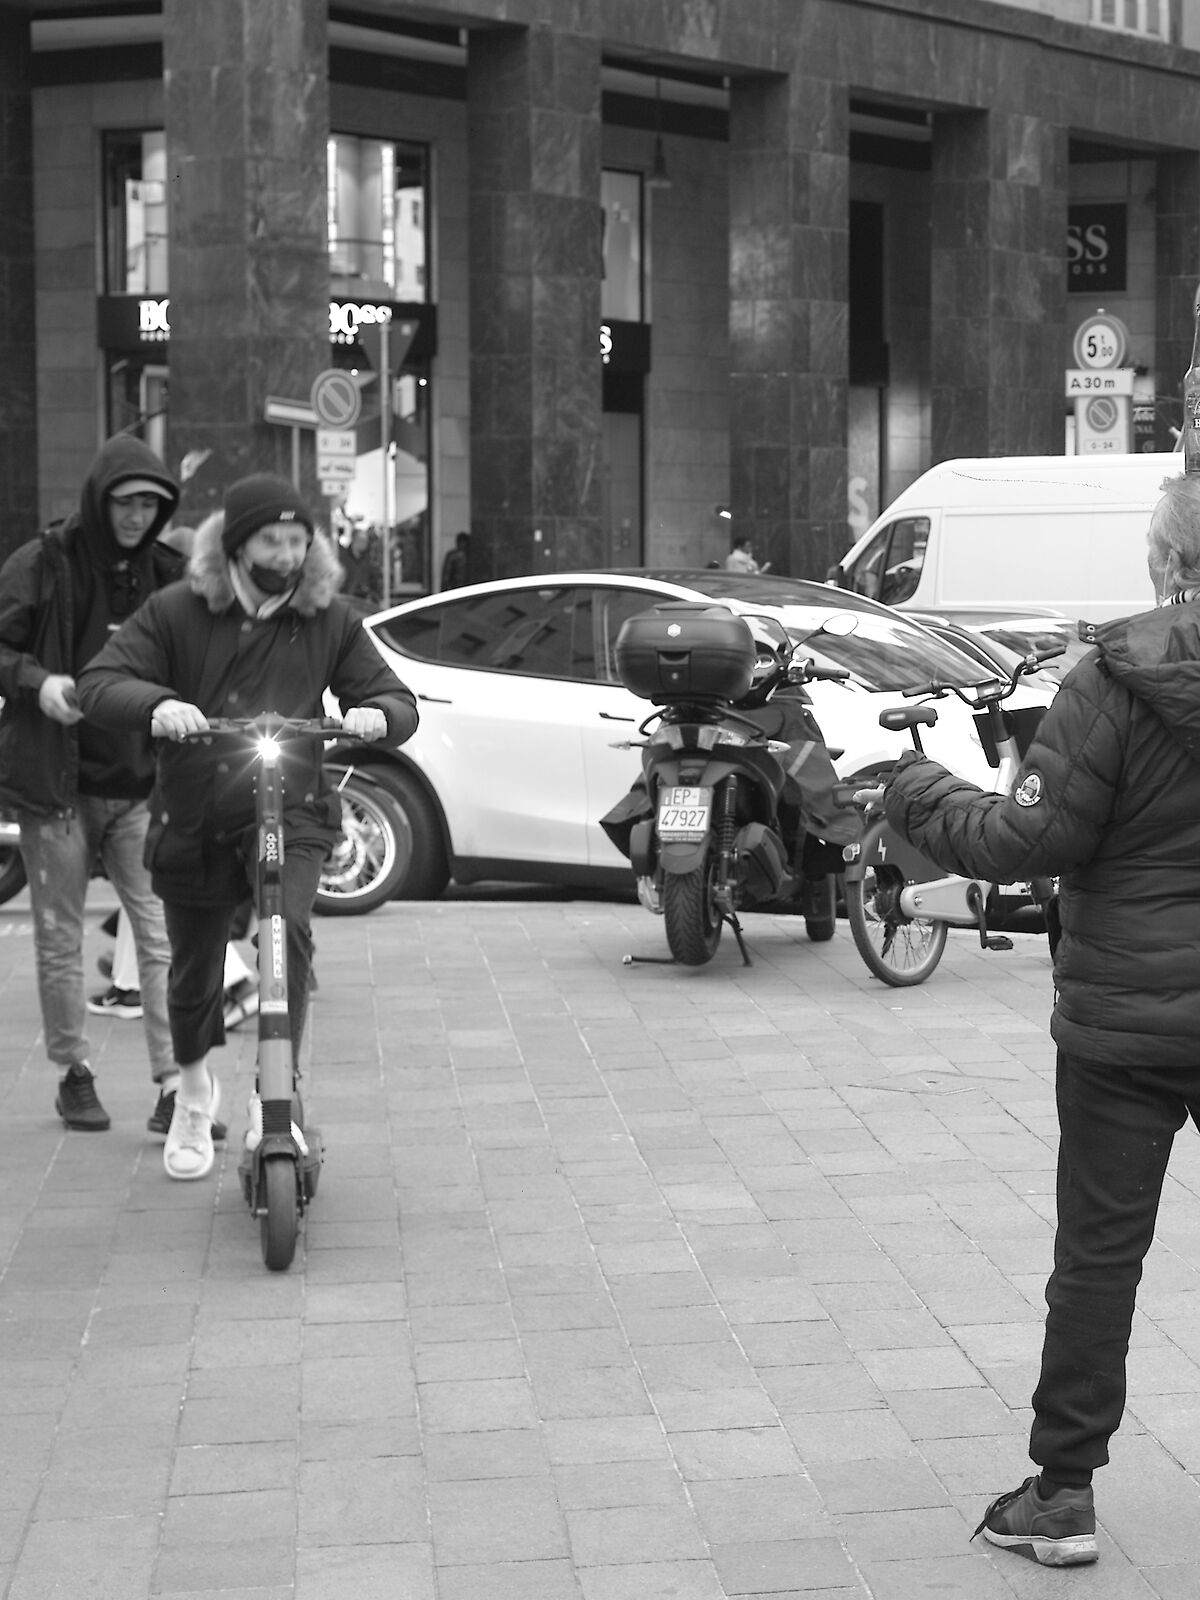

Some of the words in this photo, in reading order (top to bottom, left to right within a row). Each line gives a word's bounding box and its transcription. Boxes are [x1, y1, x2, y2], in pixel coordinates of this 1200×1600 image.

[1086, 335, 1098, 359] 5
[1070, 378, 1082, 390] A
[1083, 377, 1102, 389] 30
[1103, 379, 1116, 389] m
[673, 788, 692, 806] EP
[661, 810, 706, 827] 47927
[265, 832, 278, 863] dott
